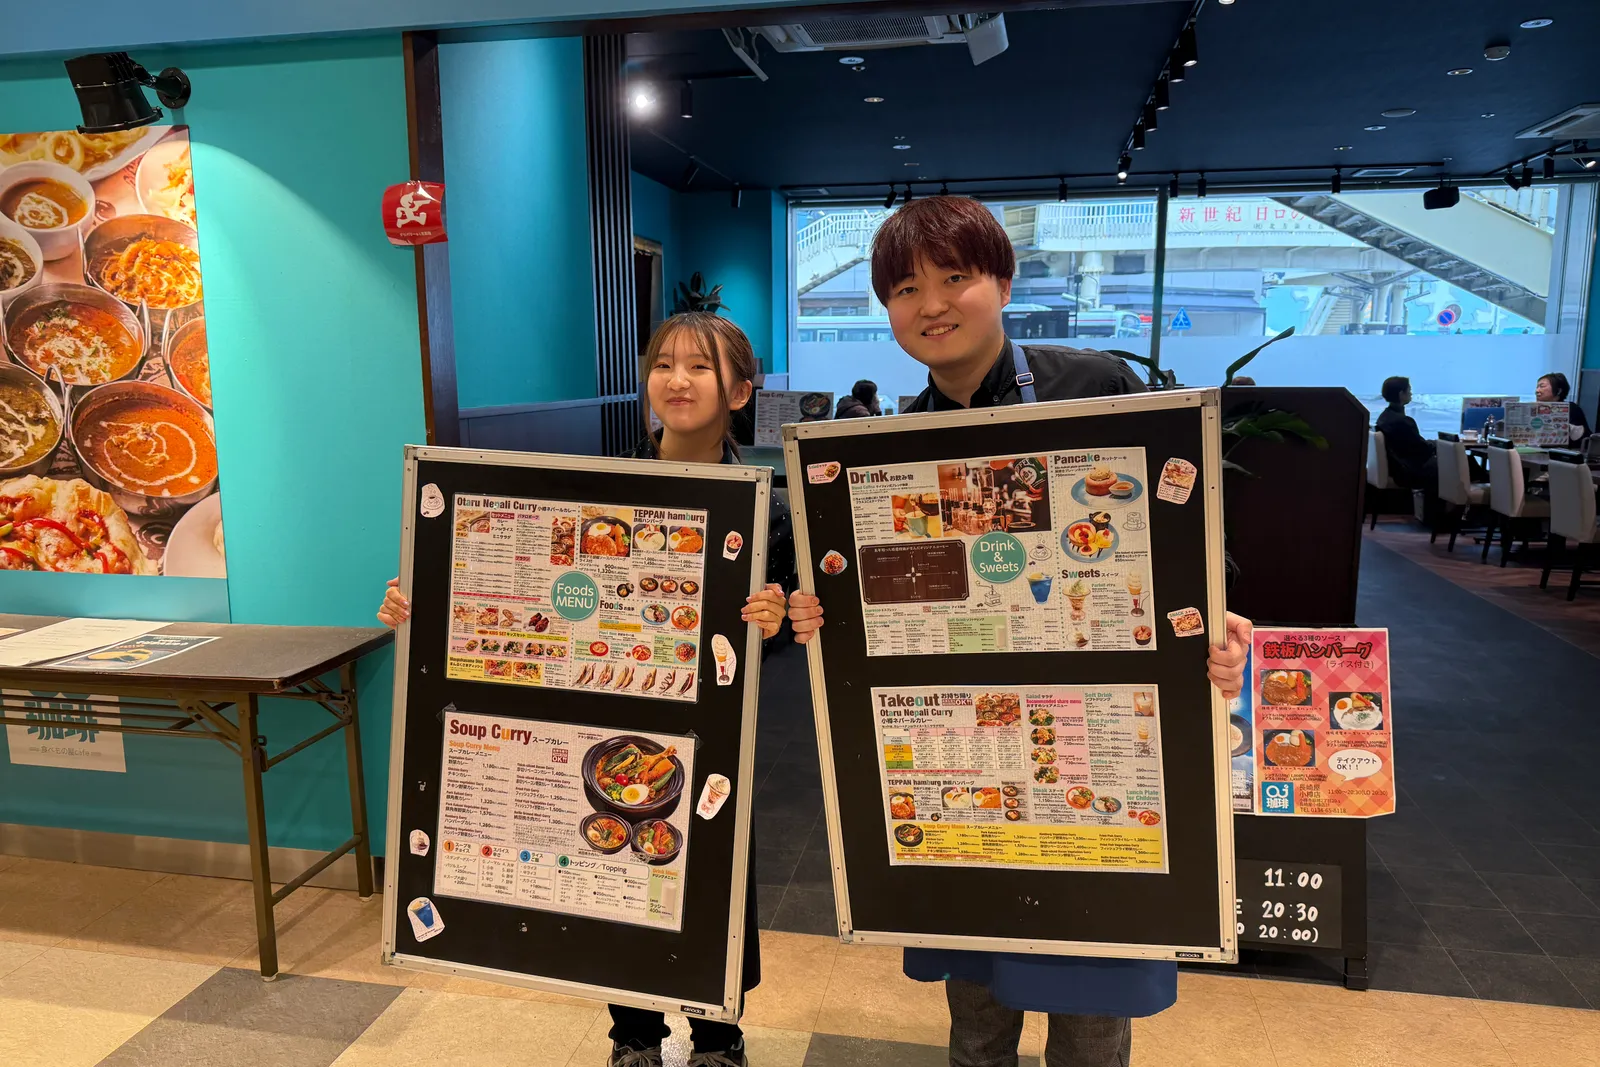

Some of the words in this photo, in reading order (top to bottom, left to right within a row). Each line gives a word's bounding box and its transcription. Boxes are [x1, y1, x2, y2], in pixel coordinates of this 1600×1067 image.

[1179, 206, 1242, 223] 新世紀
[1054, 453, 1100, 465] Pancake
[849, 469, 890, 484] Drink
[456, 497, 481, 507] Otaru
[483, 499, 511, 511] Nepali
[513, 501, 539, 513] Curry
[634, 509, 665, 519] TEPPAN
[667, 511, 705, 524] hamburg
[980, 539, 1016, 552] Drink
[993, 551, 1004, 563] &
[979, 561, 1020, 573] Sweets
[1062, 568, 1101, 579] Sweets
[556, 583, 594, 597] Foods
[556, 597, 593, 609] MENU
[600, 600, 624, 610] Foods
[1263, 641, 1373, 660] 鉄板ハンバーグ
[1326, 660, 1374, 669] (ライス付き)
[878, 693, 941, 707] Takeout
[880, 709, 902, 717] Otaru
[904, 709, 929, 719] Nepali
[934, 708, 953, 718] Curry
[881, 716, 933, 724] 小樽ネパールカレー
[450, 719, 487, 740] Soup
[491, 723, 532, 745] Curry
[532, 736, 569, 745] スープカレー
[449, 748, 492, 757] スープカレーメニュー
[1336, 757, 1377, 765] テイクアウト
[913, 780, 942, 788] hamburg
[484, 847, 490, 855] 2
[561, 857, 567, 865] 4
[1264, 867, 1324, 890] 11:00
[1261, 900, 1319, 922] 20:30
[1258, 924, 1319, 943] 20:00)
